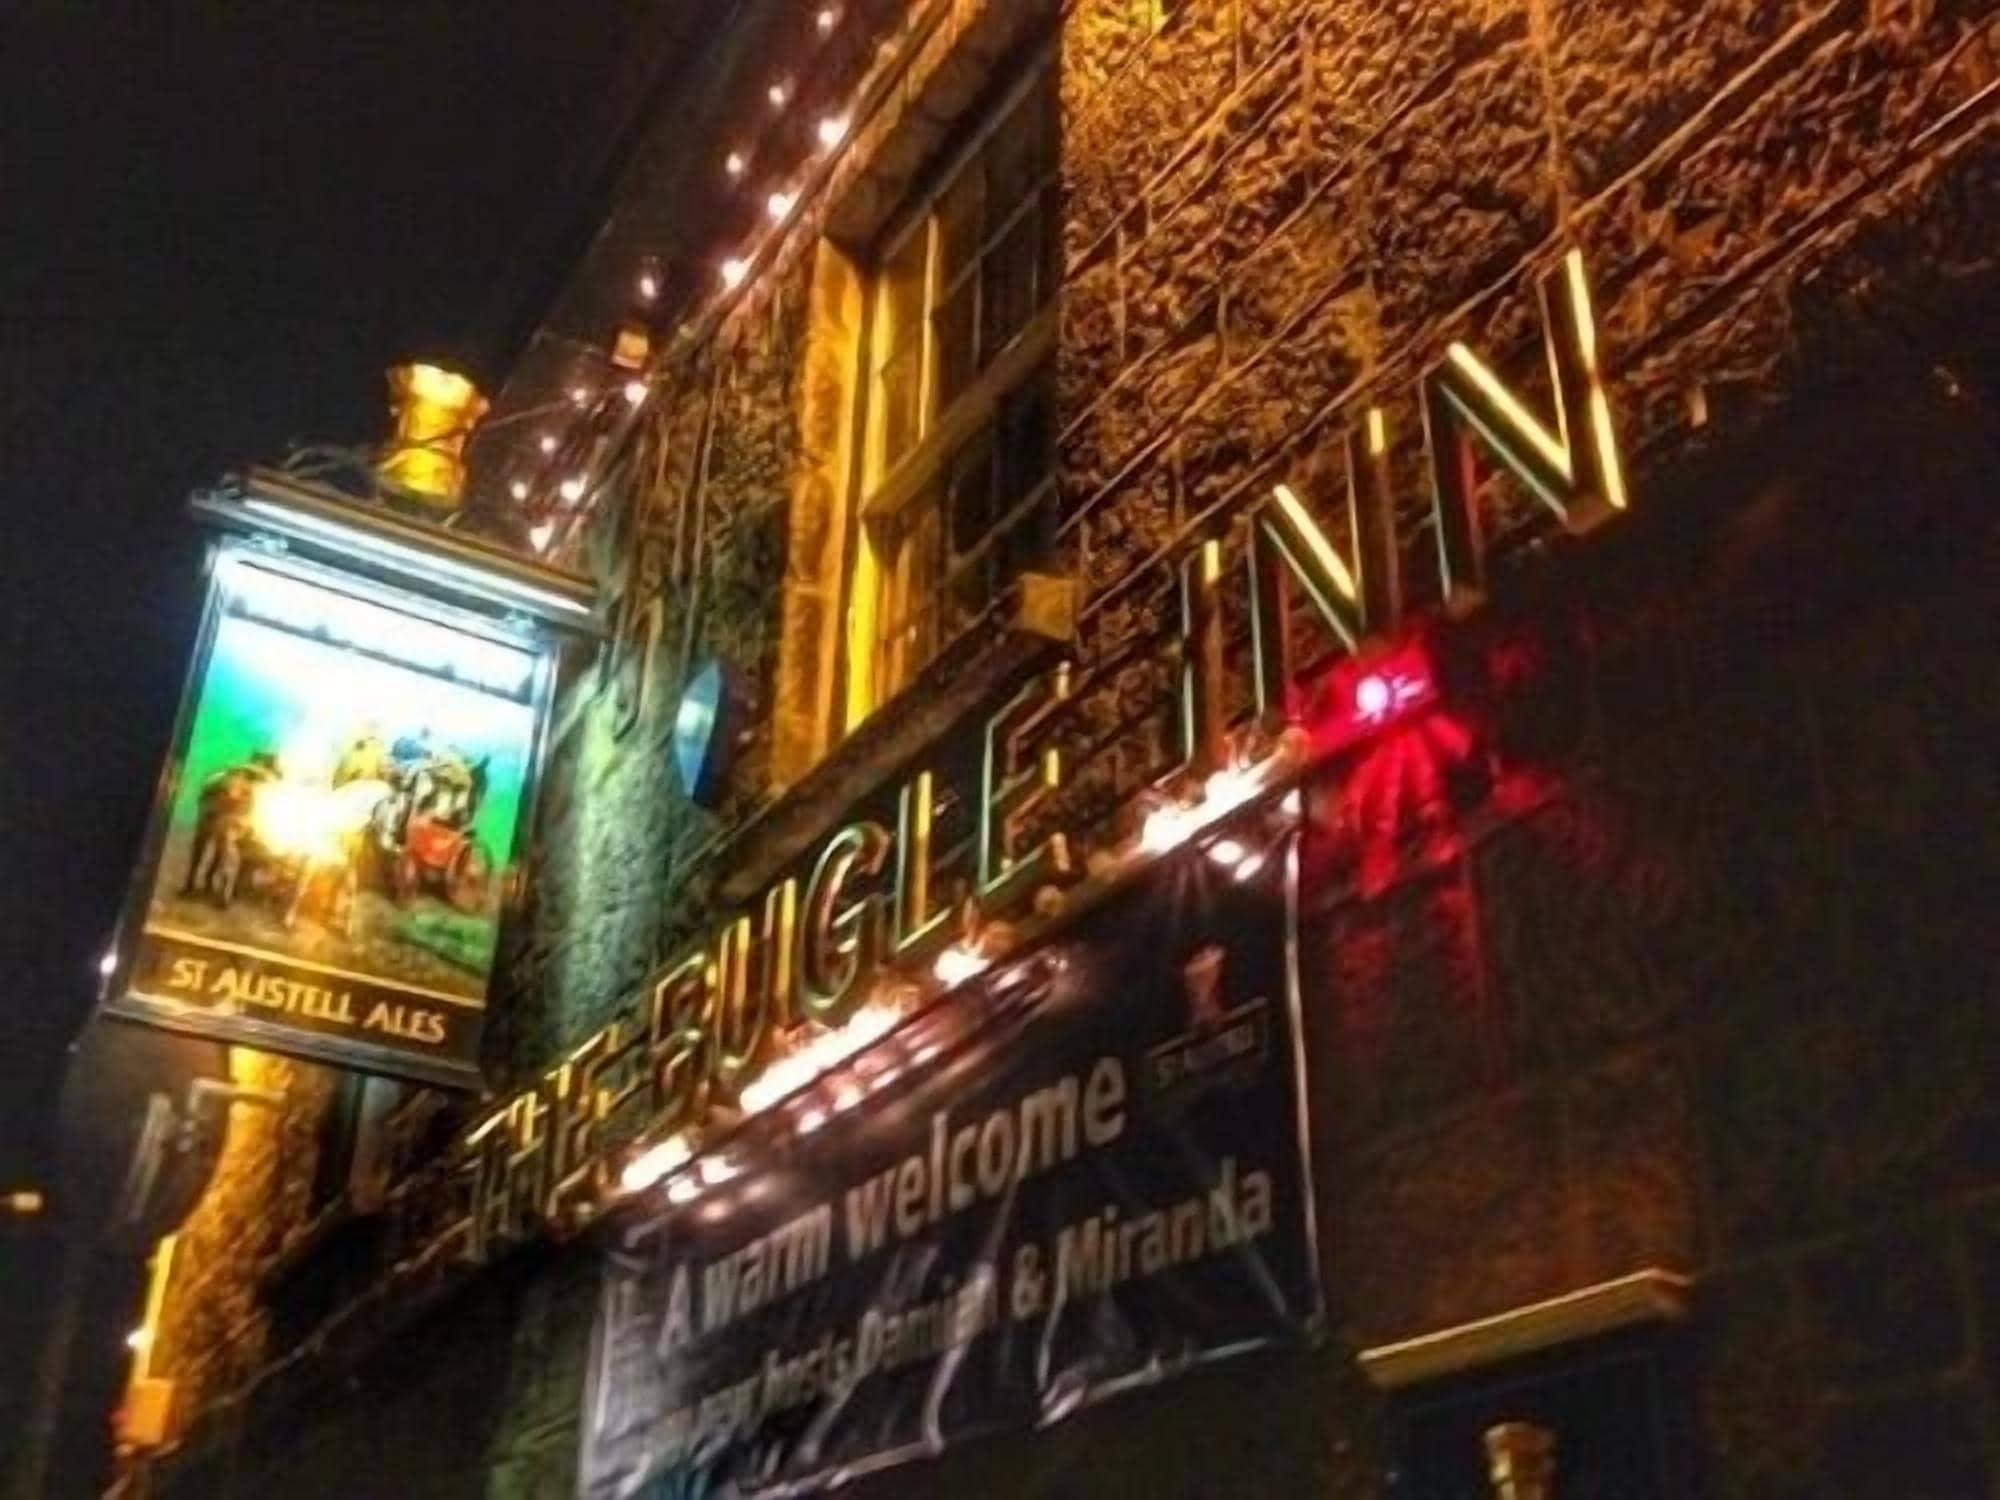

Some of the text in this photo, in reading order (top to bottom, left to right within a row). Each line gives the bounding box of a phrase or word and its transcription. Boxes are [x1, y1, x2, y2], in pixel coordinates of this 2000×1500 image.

[640, 660, 1078, 1140] BUGLE
[1180, 247, 1627, 768] INN
[170, 957, 447, 1045] ST AUSTELL ALES
[657, 1264, 692, 1357] A
[703, 1203, 833, 1333] warm
[845, 1056, 1129, 1261] welcome
[1010, 1243, 1046, 1320] &
[1056, 1155, 1273, 1297] Miranda
